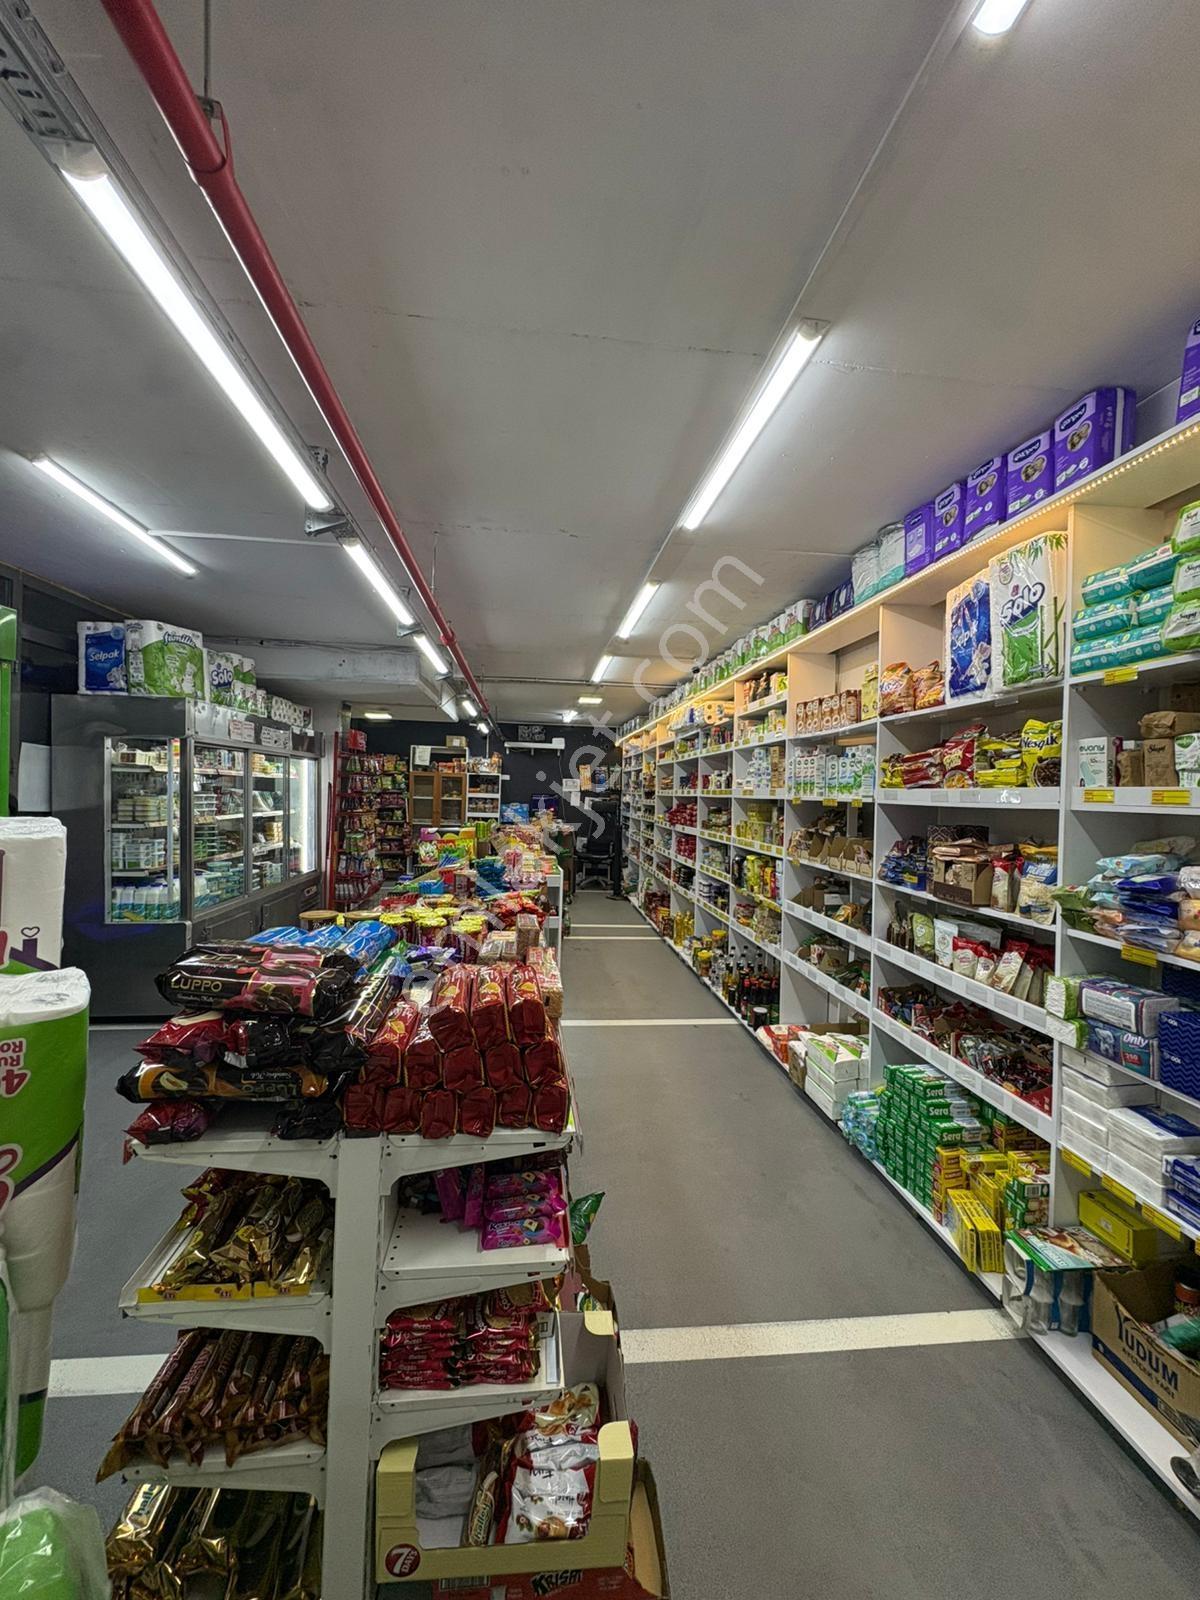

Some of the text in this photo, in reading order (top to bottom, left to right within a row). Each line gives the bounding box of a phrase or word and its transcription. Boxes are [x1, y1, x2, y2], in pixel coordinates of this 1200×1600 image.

[89, 649, 120, 662] Selpak
[211, 669, 234, 684] Solo
[171, 976, 222, 993] LUPPO
[1123, 1033, 1149, 1047] Only
[2, 1069, 28, 1095] 4
[926, 1088, 944, 1097] Sera
[929, 1106, 949, 1116] Sera
[942, 1132, 961, 1142] Sera
[1115, 1303, 1179, 1392] YUDUM
[473, 1502, 492, 1545] halley
[392, 1548, 418, 1574] 7 DAYS
